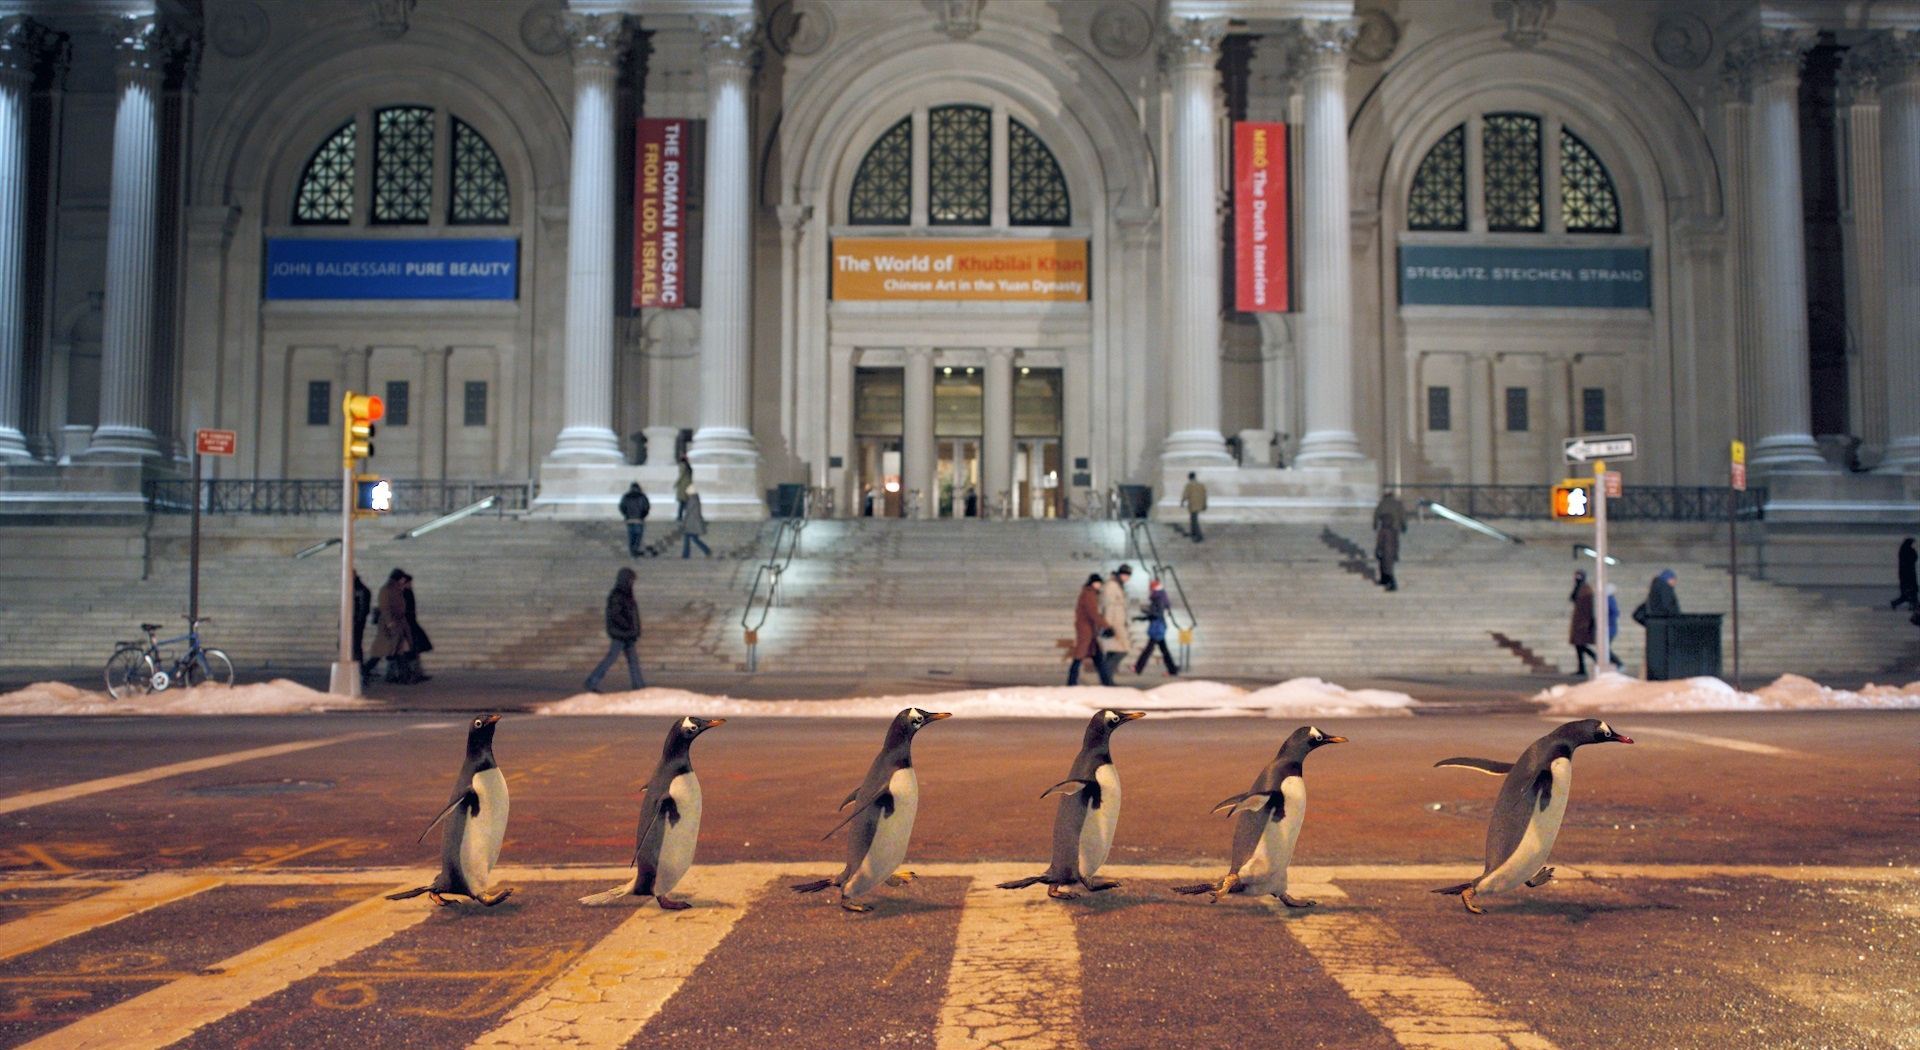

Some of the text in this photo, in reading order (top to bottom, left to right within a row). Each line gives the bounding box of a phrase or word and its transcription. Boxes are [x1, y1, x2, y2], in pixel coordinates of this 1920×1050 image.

[1252, 169, 1268, 197] The
[641, 142, 659, 305] FROM LOD, ISRAEL
[660, 123, 681, 304] THE ROMAN MOSAIC
[1252, 199, 1268, 242] Dutch
[272, 262, 511, 277] JOHN BALDESSARI PURE BEAUTY
[837, 254, 1084, 272] The World of Khubilai Khan
[1253, 244, 1268, 305] Interiors
[1577, 268, 1644, 283] STRAND
[883, 279, 1082, 295] Chinese Art in the Yuan Dynasty
